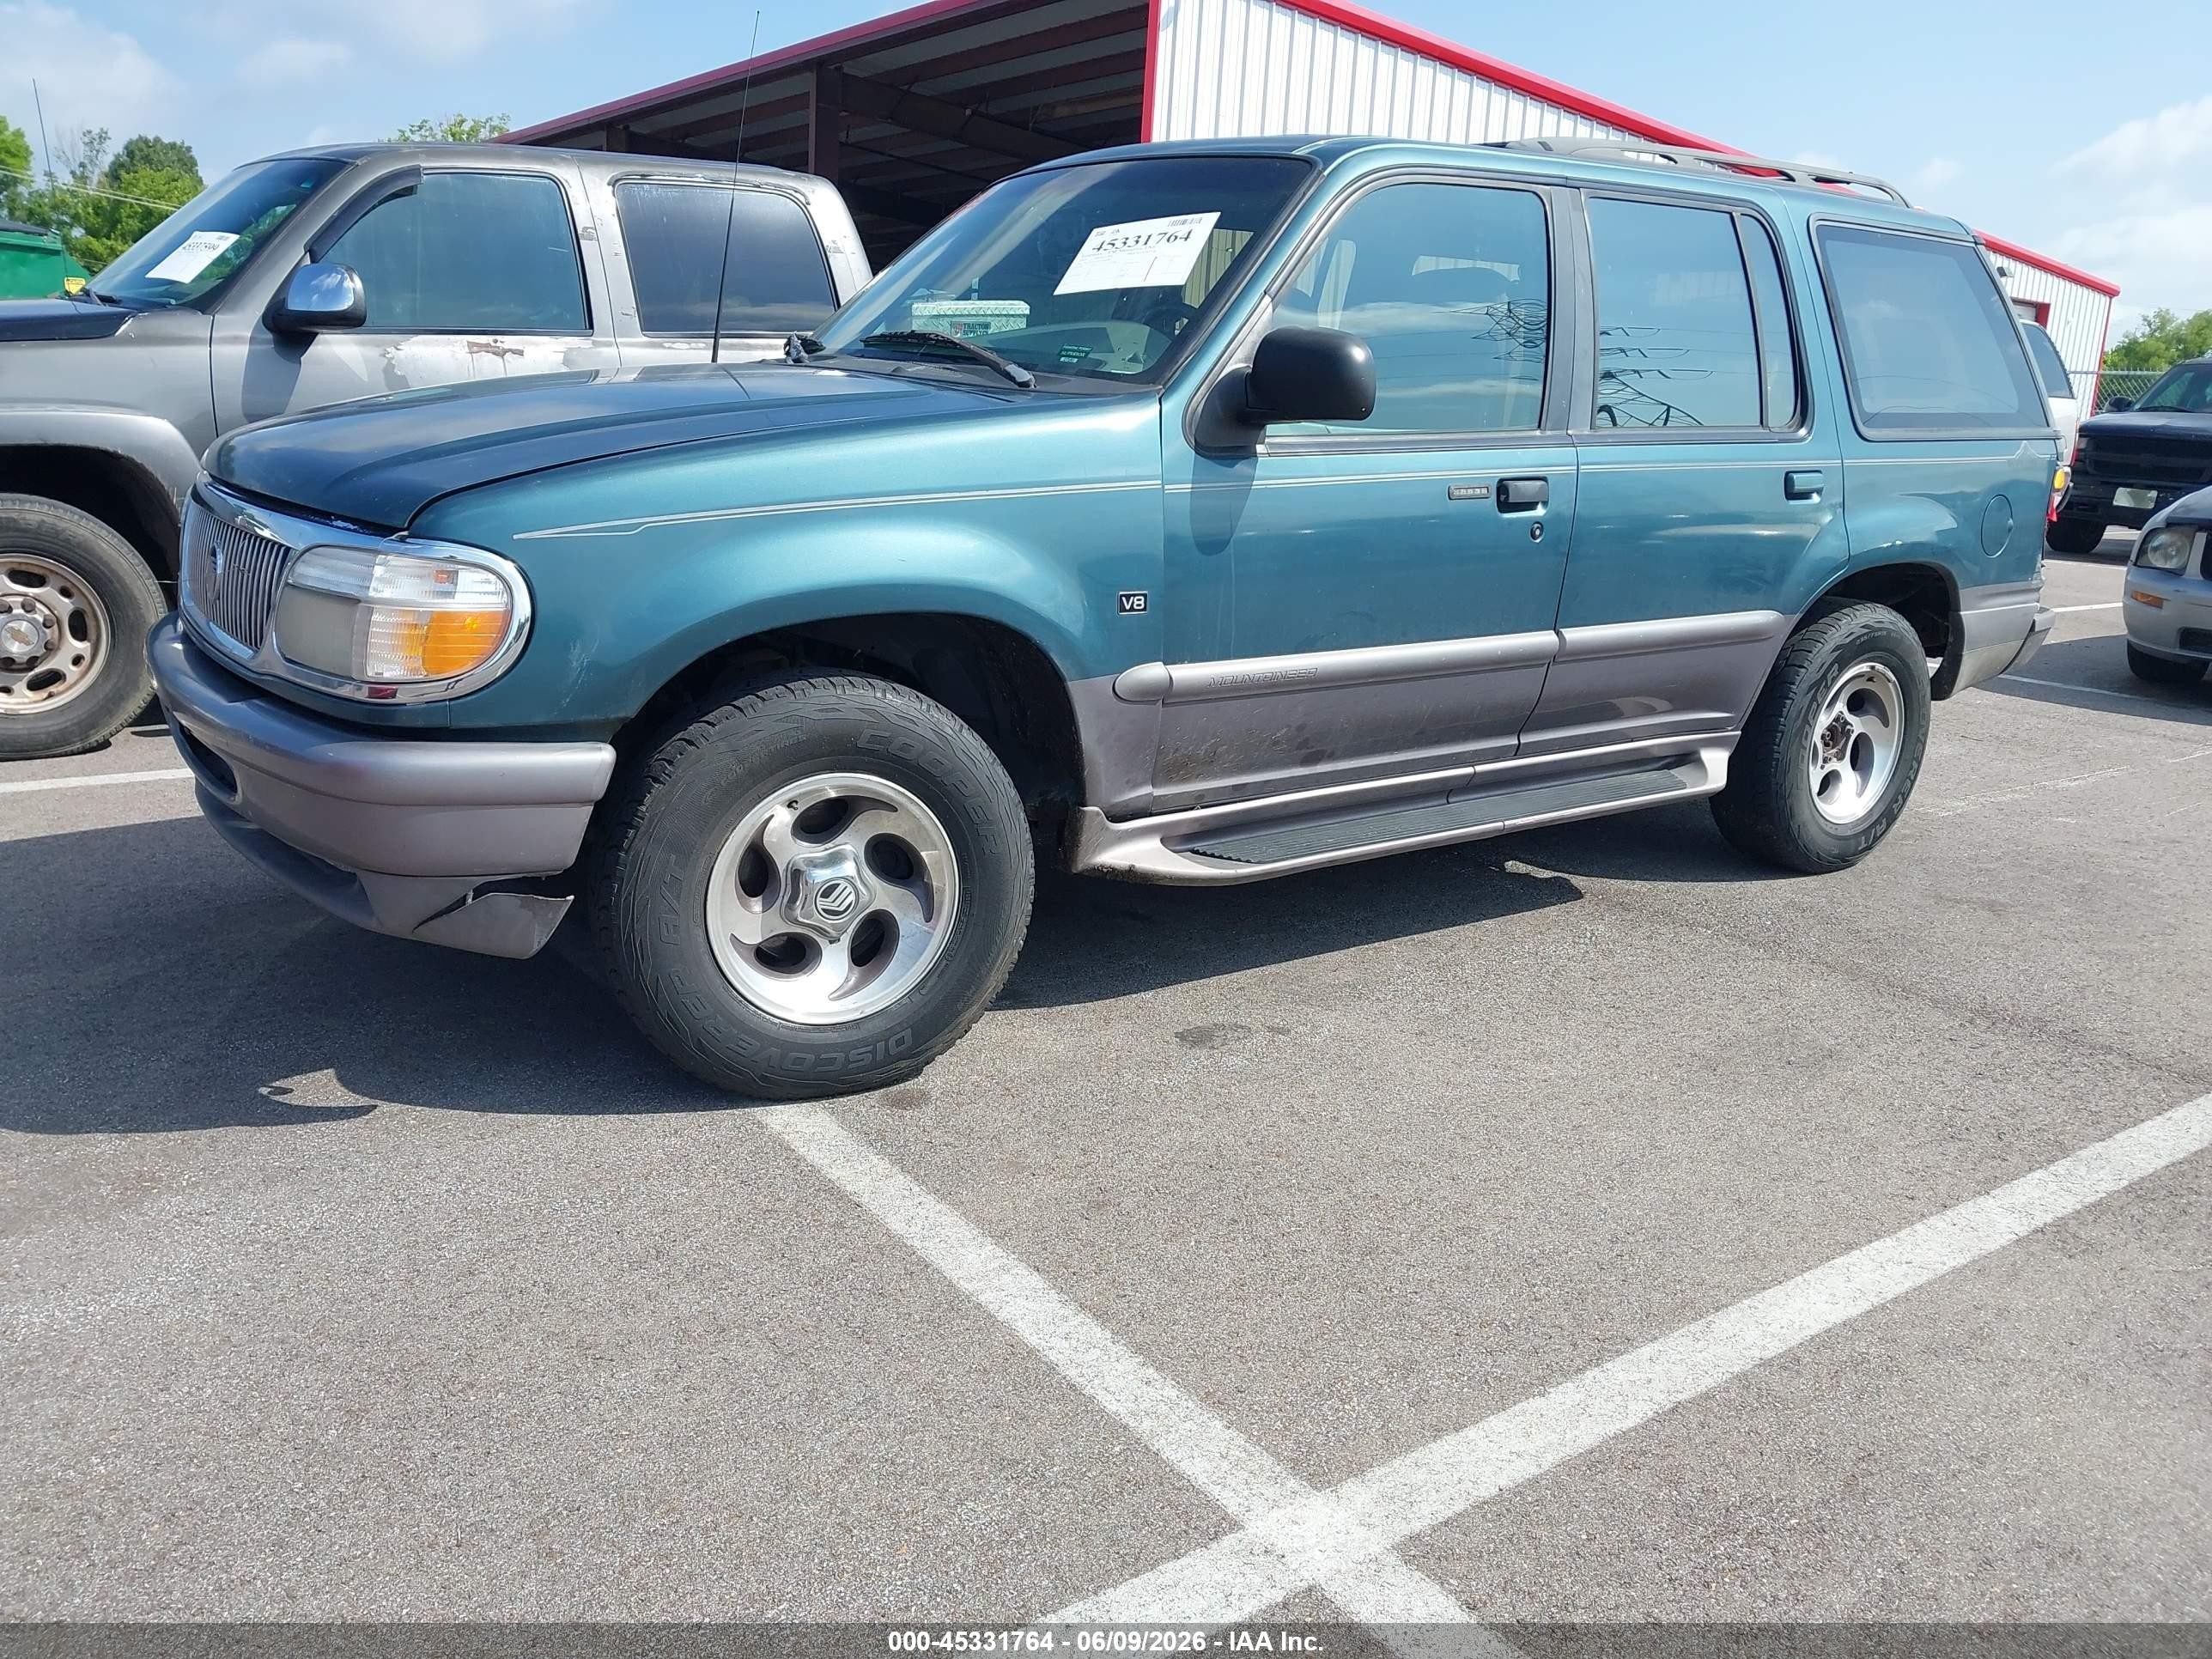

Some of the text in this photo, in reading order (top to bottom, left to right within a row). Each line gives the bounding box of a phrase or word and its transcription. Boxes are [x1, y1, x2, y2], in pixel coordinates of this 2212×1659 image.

[1091, 228, 1194, 252] 45331764
[1121, 596, 1145, 610] V8
[1208, 667, 1318, 688] MOUNTAINEER
[856, 728, 999, 855] COOPER
[668, 968, 914, 1073] DISCOVERER
